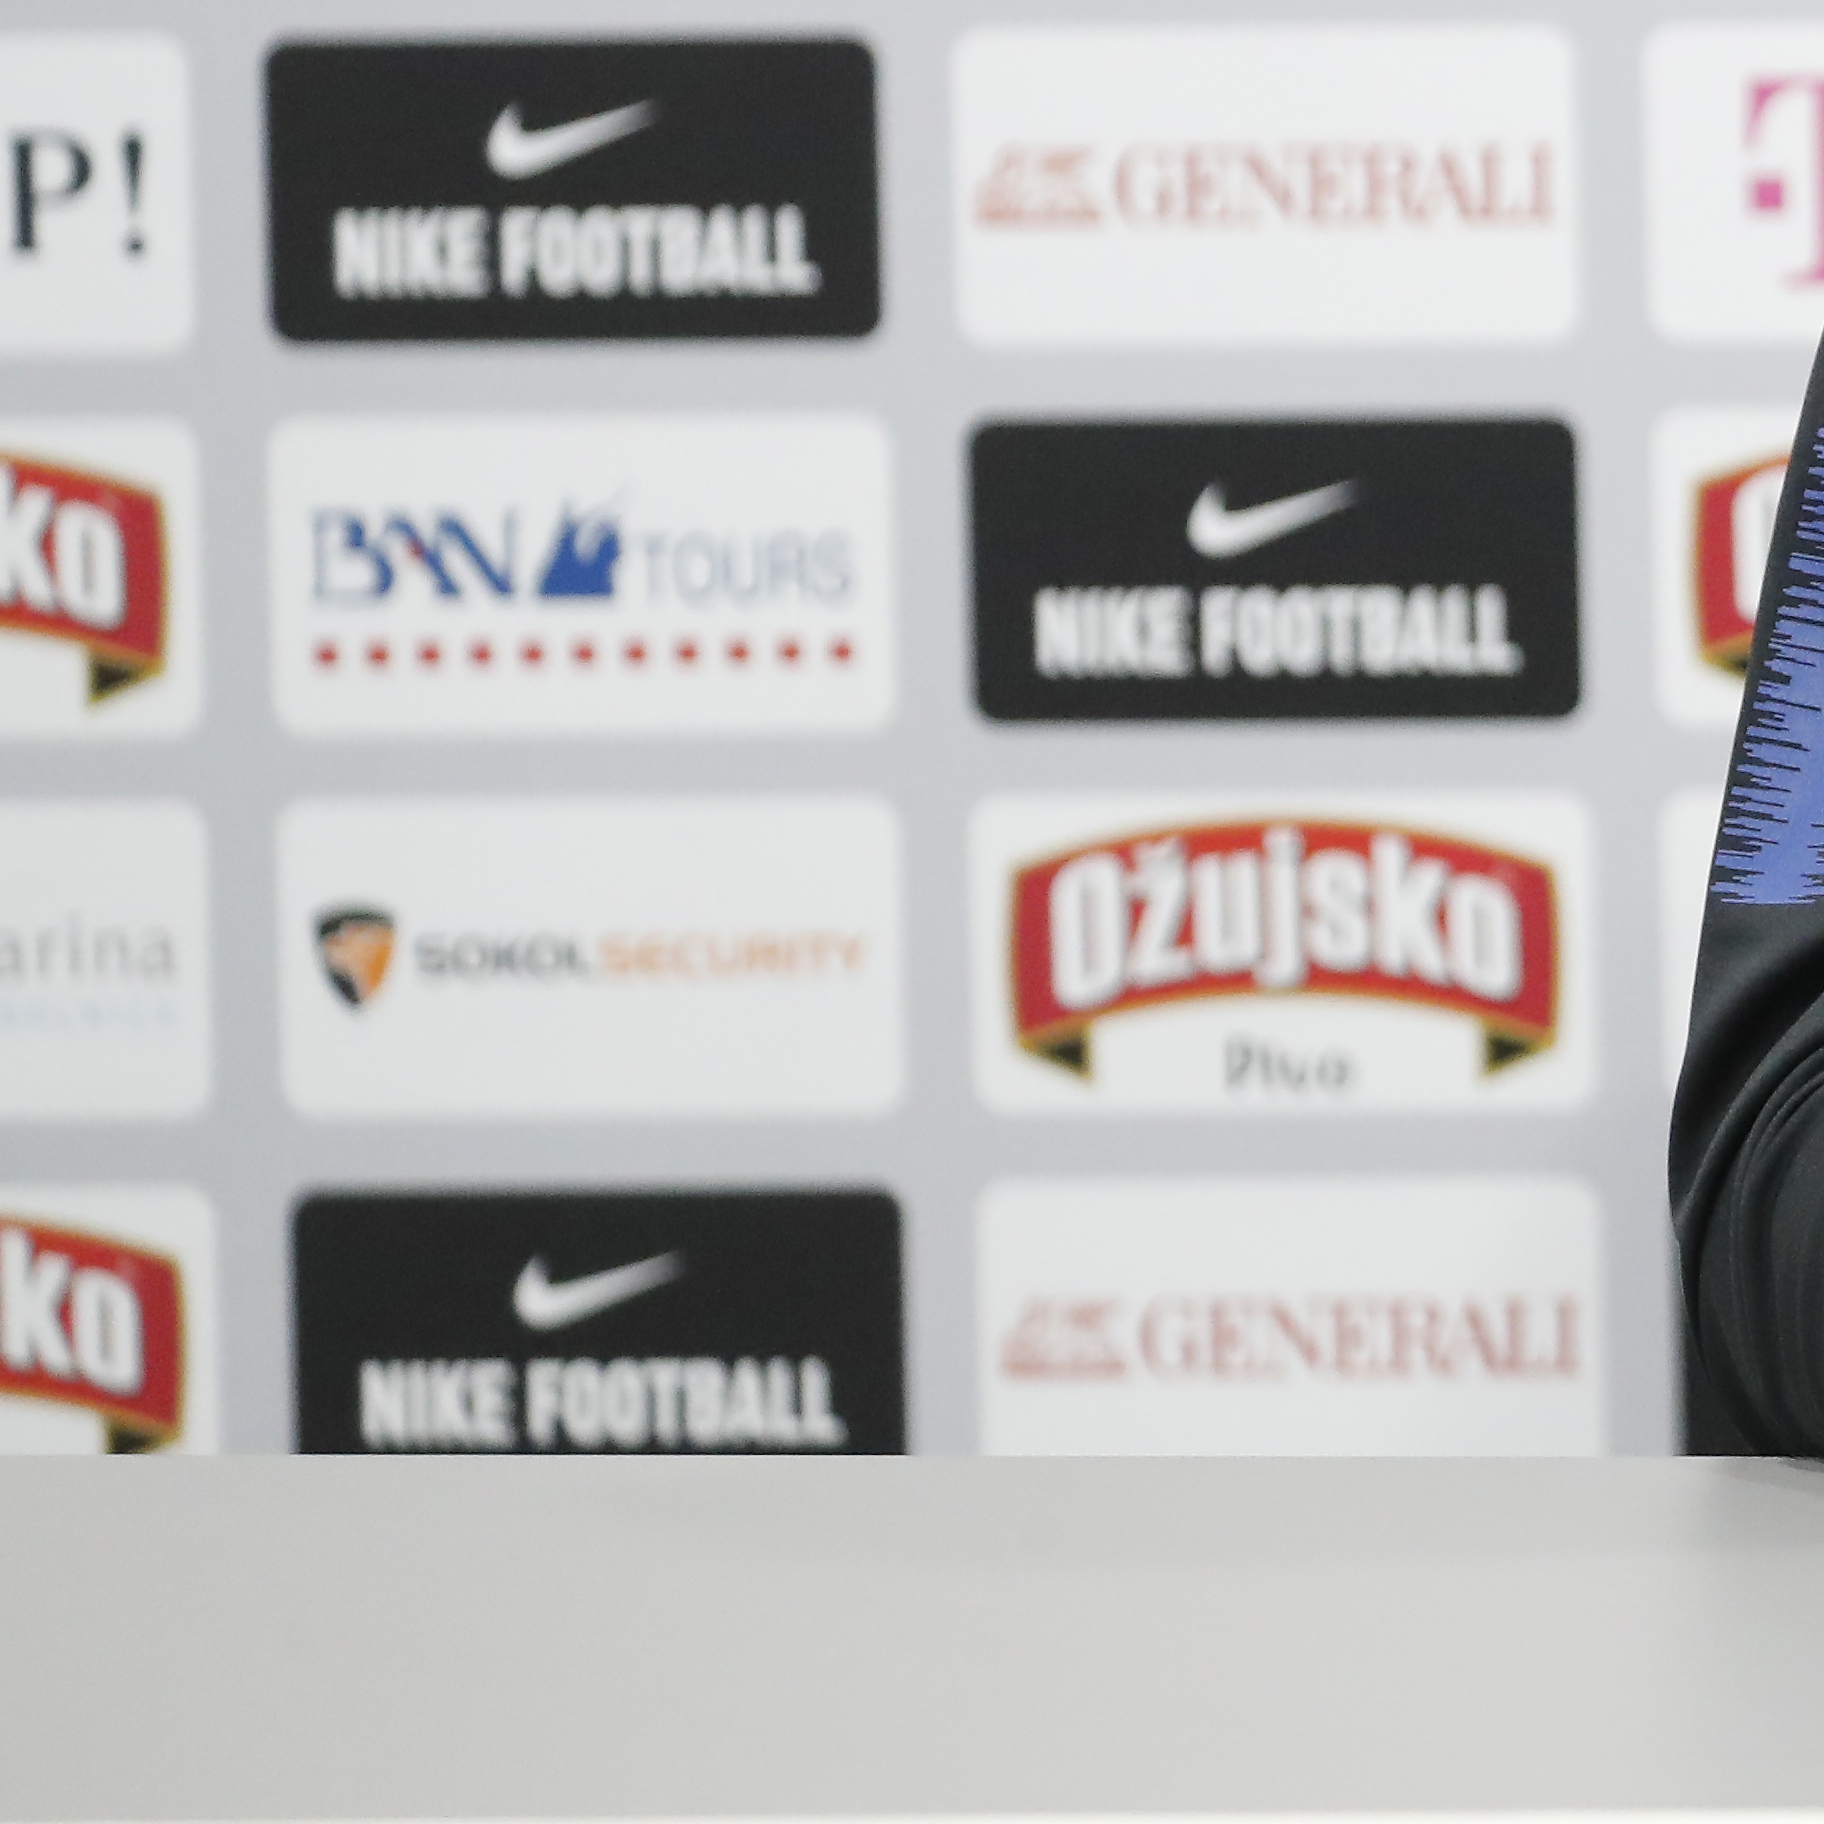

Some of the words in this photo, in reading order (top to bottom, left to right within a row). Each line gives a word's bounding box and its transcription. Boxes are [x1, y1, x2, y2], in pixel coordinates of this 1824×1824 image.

[1112, 143, 1554, 229] GENERALI
[334, 206, 488, 298] NIKE
[499, 206, 821, 298] FOOTBALL
[1035, 586, 1191, 676] NIKE
[1200, 586, 1522, 676] FOOTBALL
[1048, 828, 1522, 1010] Ožujsko
[1140, 1294, 1579, 1378] GENERALI
[360, 1356, 513, 1447] NIKE
[527, 1356, 846, 1447] FOOTBALL
